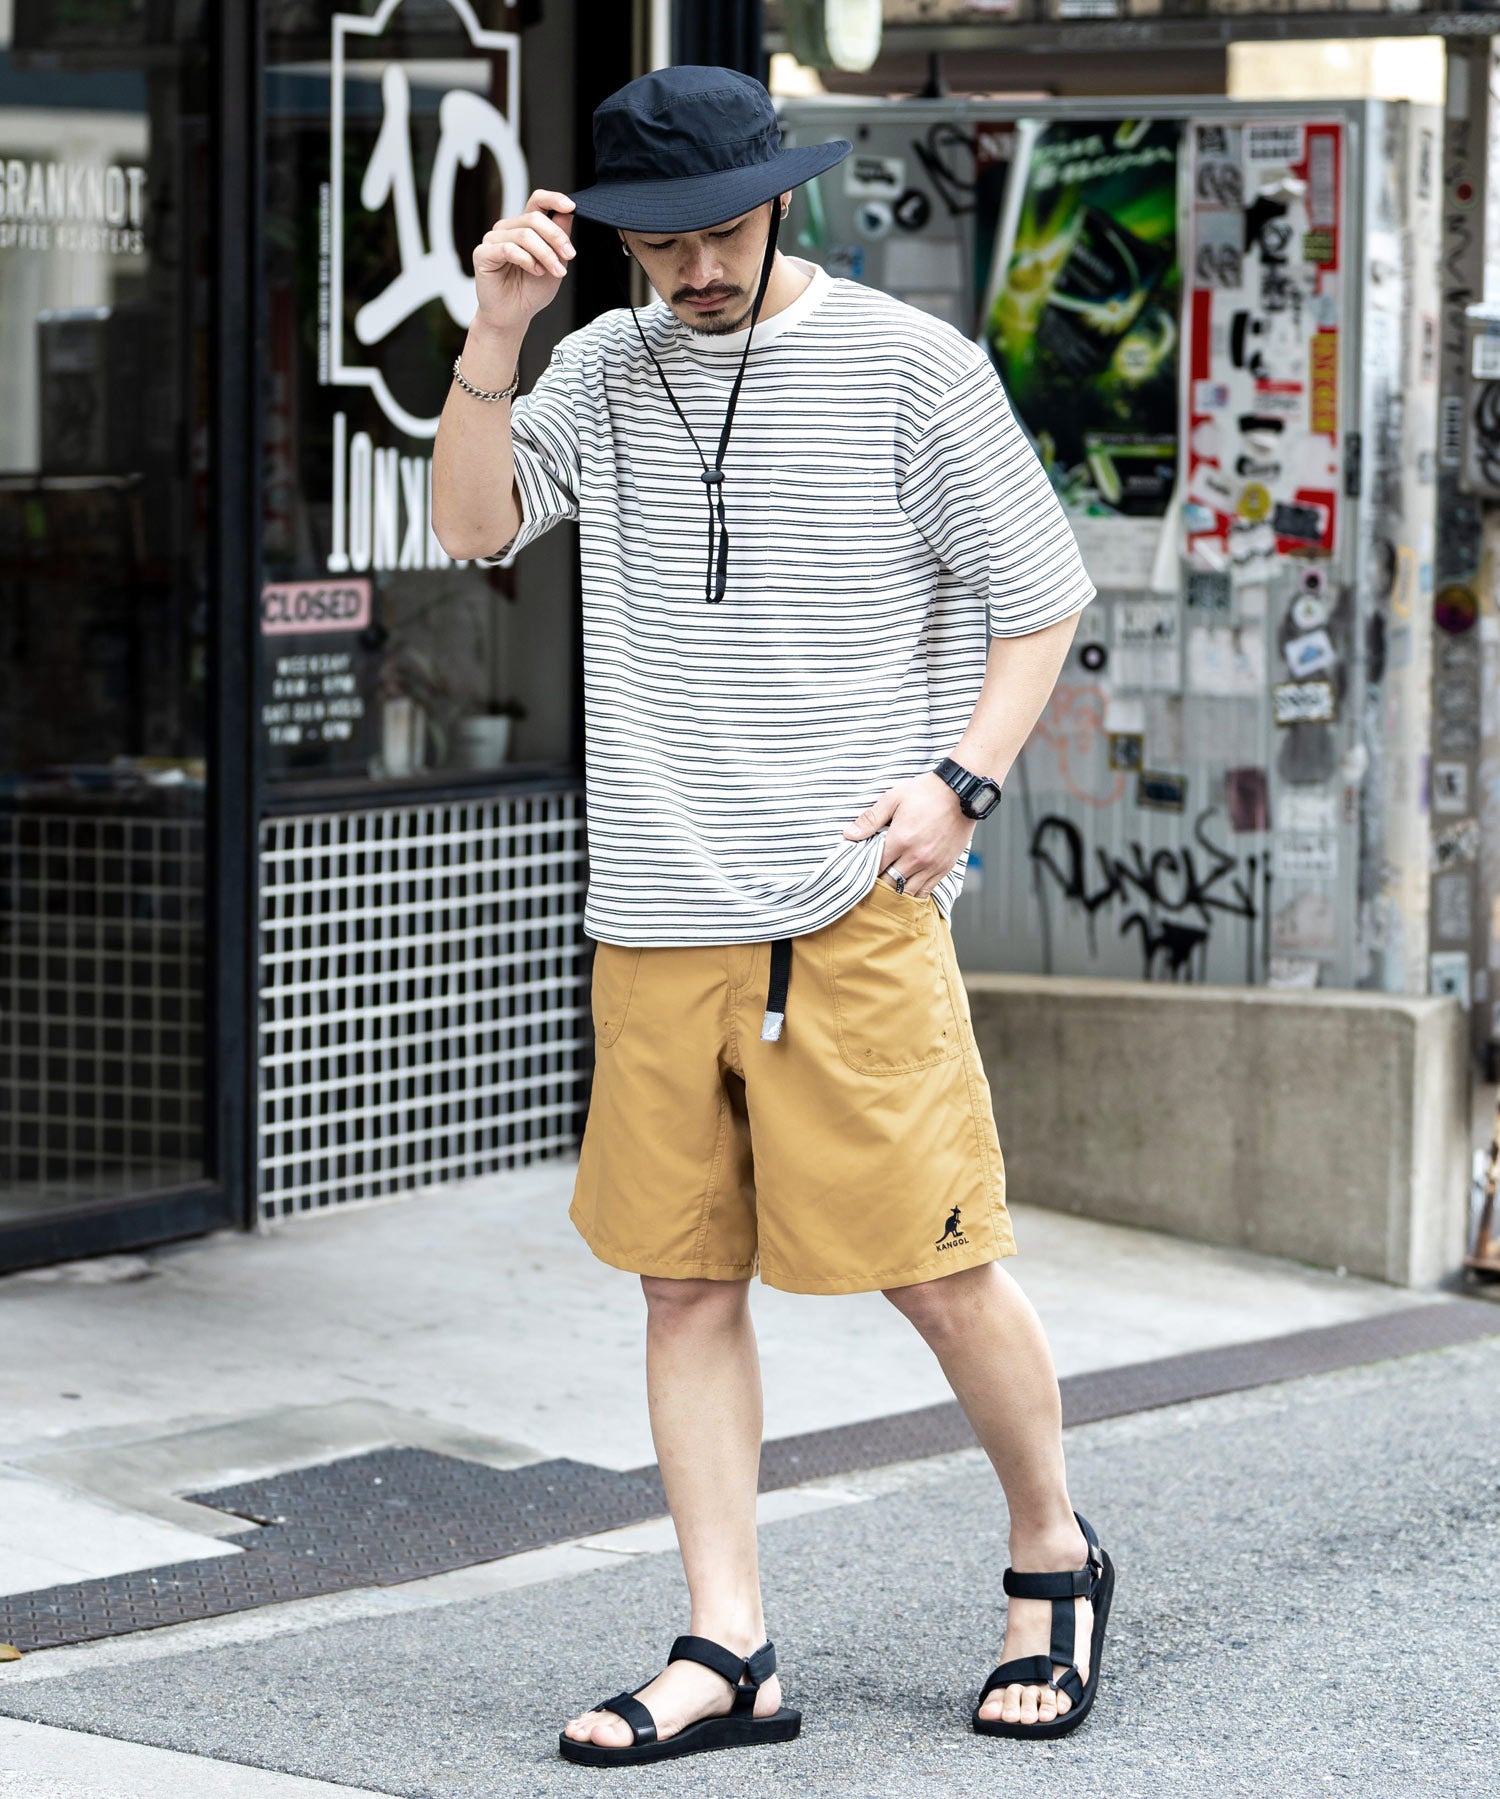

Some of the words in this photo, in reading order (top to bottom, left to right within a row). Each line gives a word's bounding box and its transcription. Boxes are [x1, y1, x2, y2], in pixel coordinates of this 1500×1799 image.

[0, 223, 49, 251] OFFEE
[262, 588, 362, 623] CLOSED
[936, 1237, 970, 1252] KANGOL
